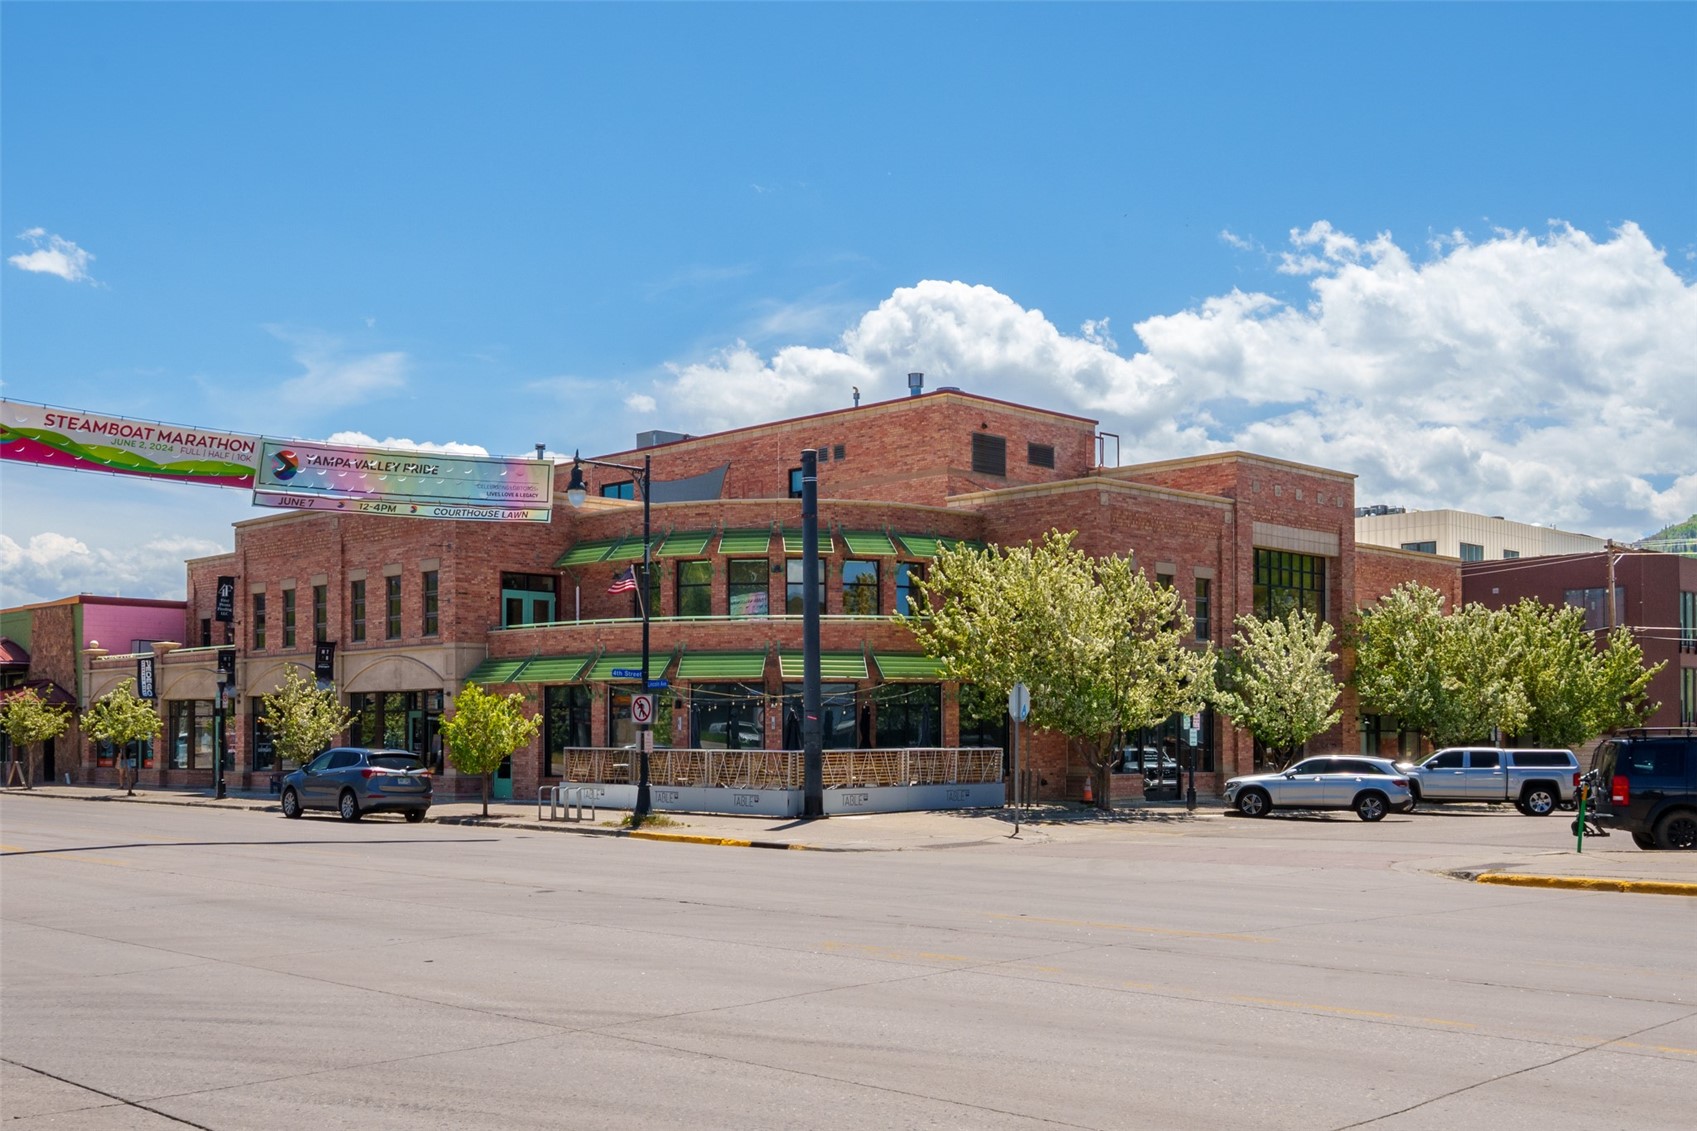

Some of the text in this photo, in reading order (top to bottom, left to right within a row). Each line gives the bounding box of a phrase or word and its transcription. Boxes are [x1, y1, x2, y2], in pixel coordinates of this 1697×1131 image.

[44, 413, 255, 453] STEAMBOAT MARATHON
[111, 438, 174, 452] JUNE 2, 2024
[180, 446, 252, 462] FULL HALF 10K
[306, 454, 440, 475] YAMPA VALLEY PRIDE
[278, 496, 315, 508] JUNE 7
[359, 502, 397, 513] 12-4PM
[434, 507, 529, 519] COURTHOUSE LAWN
[733, 794, 754, 807] TABLE
[842, 793, 863, 806] TABLE
